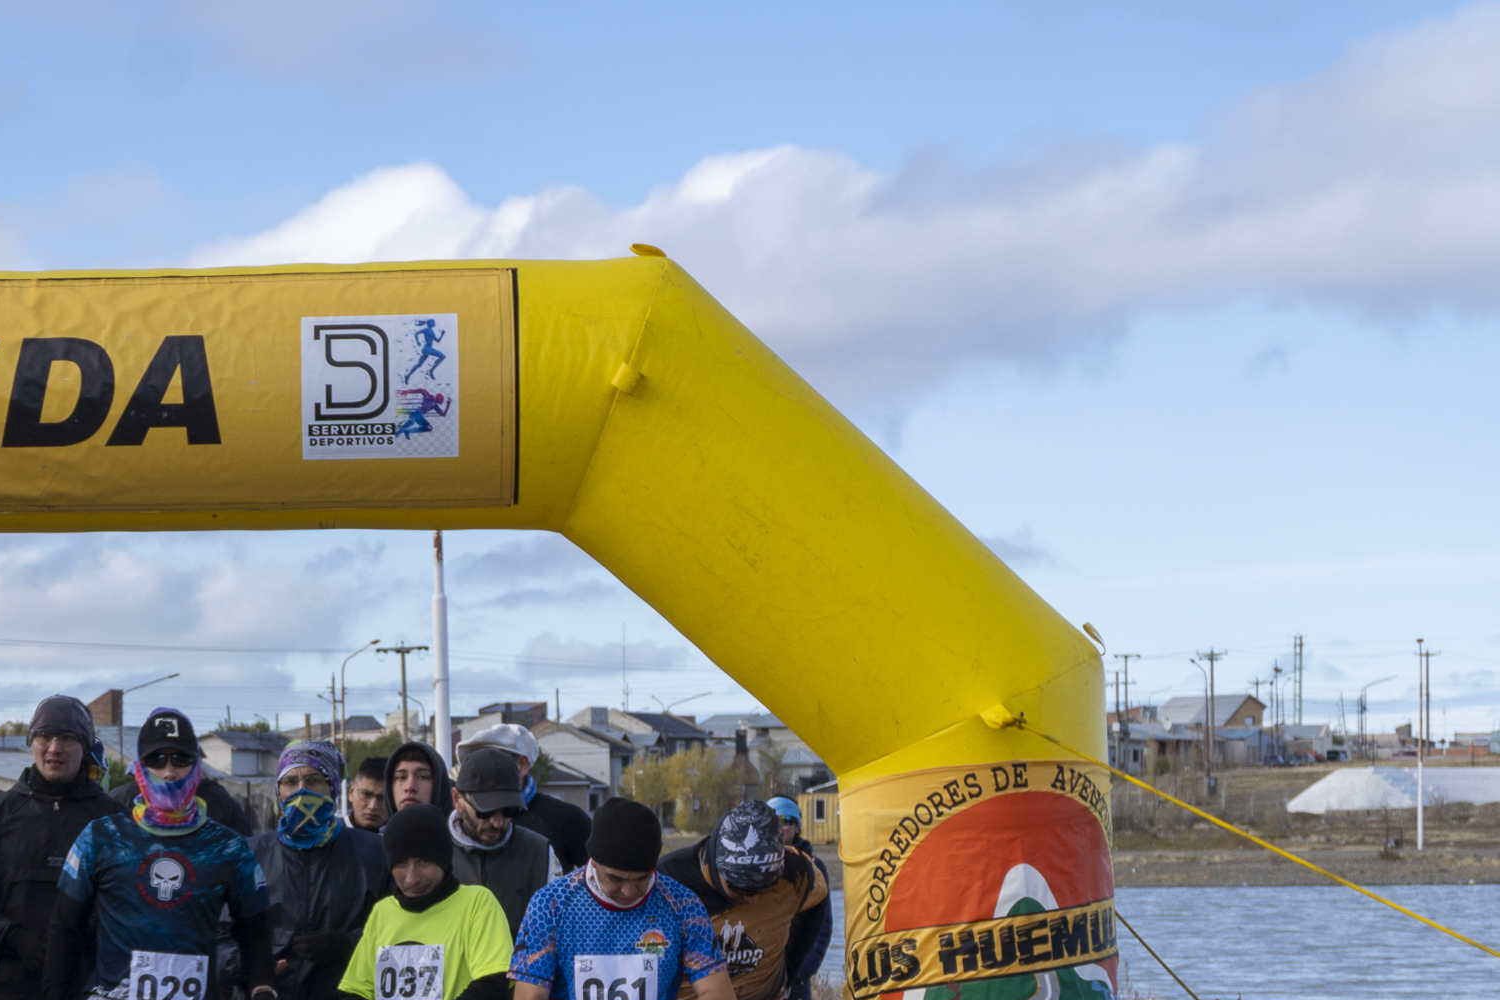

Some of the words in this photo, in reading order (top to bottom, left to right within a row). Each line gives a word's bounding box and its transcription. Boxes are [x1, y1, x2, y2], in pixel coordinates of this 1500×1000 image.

[309, 437, 394, 446] DEPORTIVOS
[311, 424, 393, 435] SERVICIOS
[866, 772, 983, 922] CORREDORES
[993, 763, 1029, 793] DE
[851, 938, 921, 990] LOS
[381, 966, 439, 998] 037
